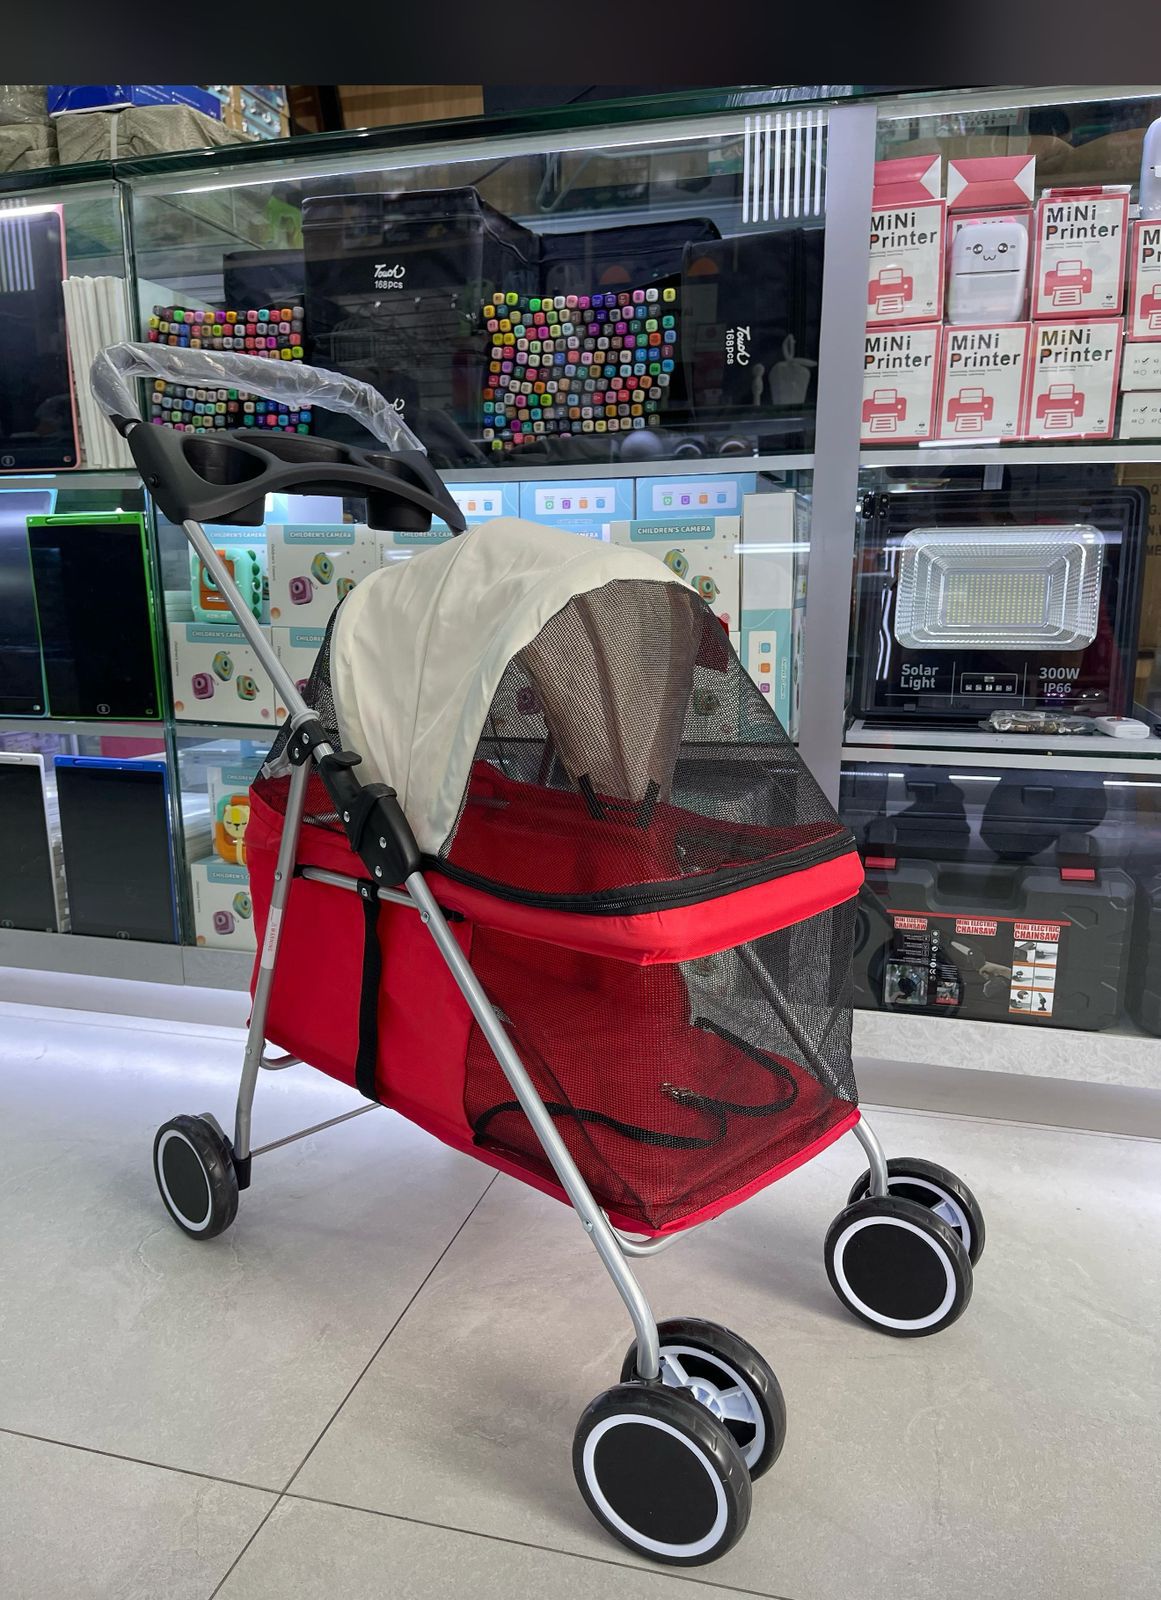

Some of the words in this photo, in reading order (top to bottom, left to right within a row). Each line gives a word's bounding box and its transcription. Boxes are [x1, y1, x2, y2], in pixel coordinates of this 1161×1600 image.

[871, 212, 915, 232] MiNi
[1047, 205, 1096, 223] MiNi
[870, 231, 937, 249] Printer
[1046, 224, 1119, 240] Printer
[374, 263, 405, 278] Touch
[374, 280, 403, 290] 168pcs
[865, 335, 911, 353] MiNi
[951, 333, 999, 351] MiNi
[1041, 329, 1091, 346] MiNi
[725, 328, 735, 365] 168pcs
[736, 326, 751, 366] Touch
[864, 353, 932, 370] Printer
[950, 352, 1021, 368] Printer
[1040, 347, 1113, 363] Printer
[680, 525, 711, 533] CAMERA
[901, 663, 939, 676] Solar
[1039, 667, 1080, 680] 300W
[900, 676, 936, 690] Light
[1043, 683, 1072, 693] IP66
[956, 926, 996, 935] CHAINSAW
[1014, 931, 1059, 940] CHAINSAW
[1030, 925, 1060, 933] ELECTRIC
